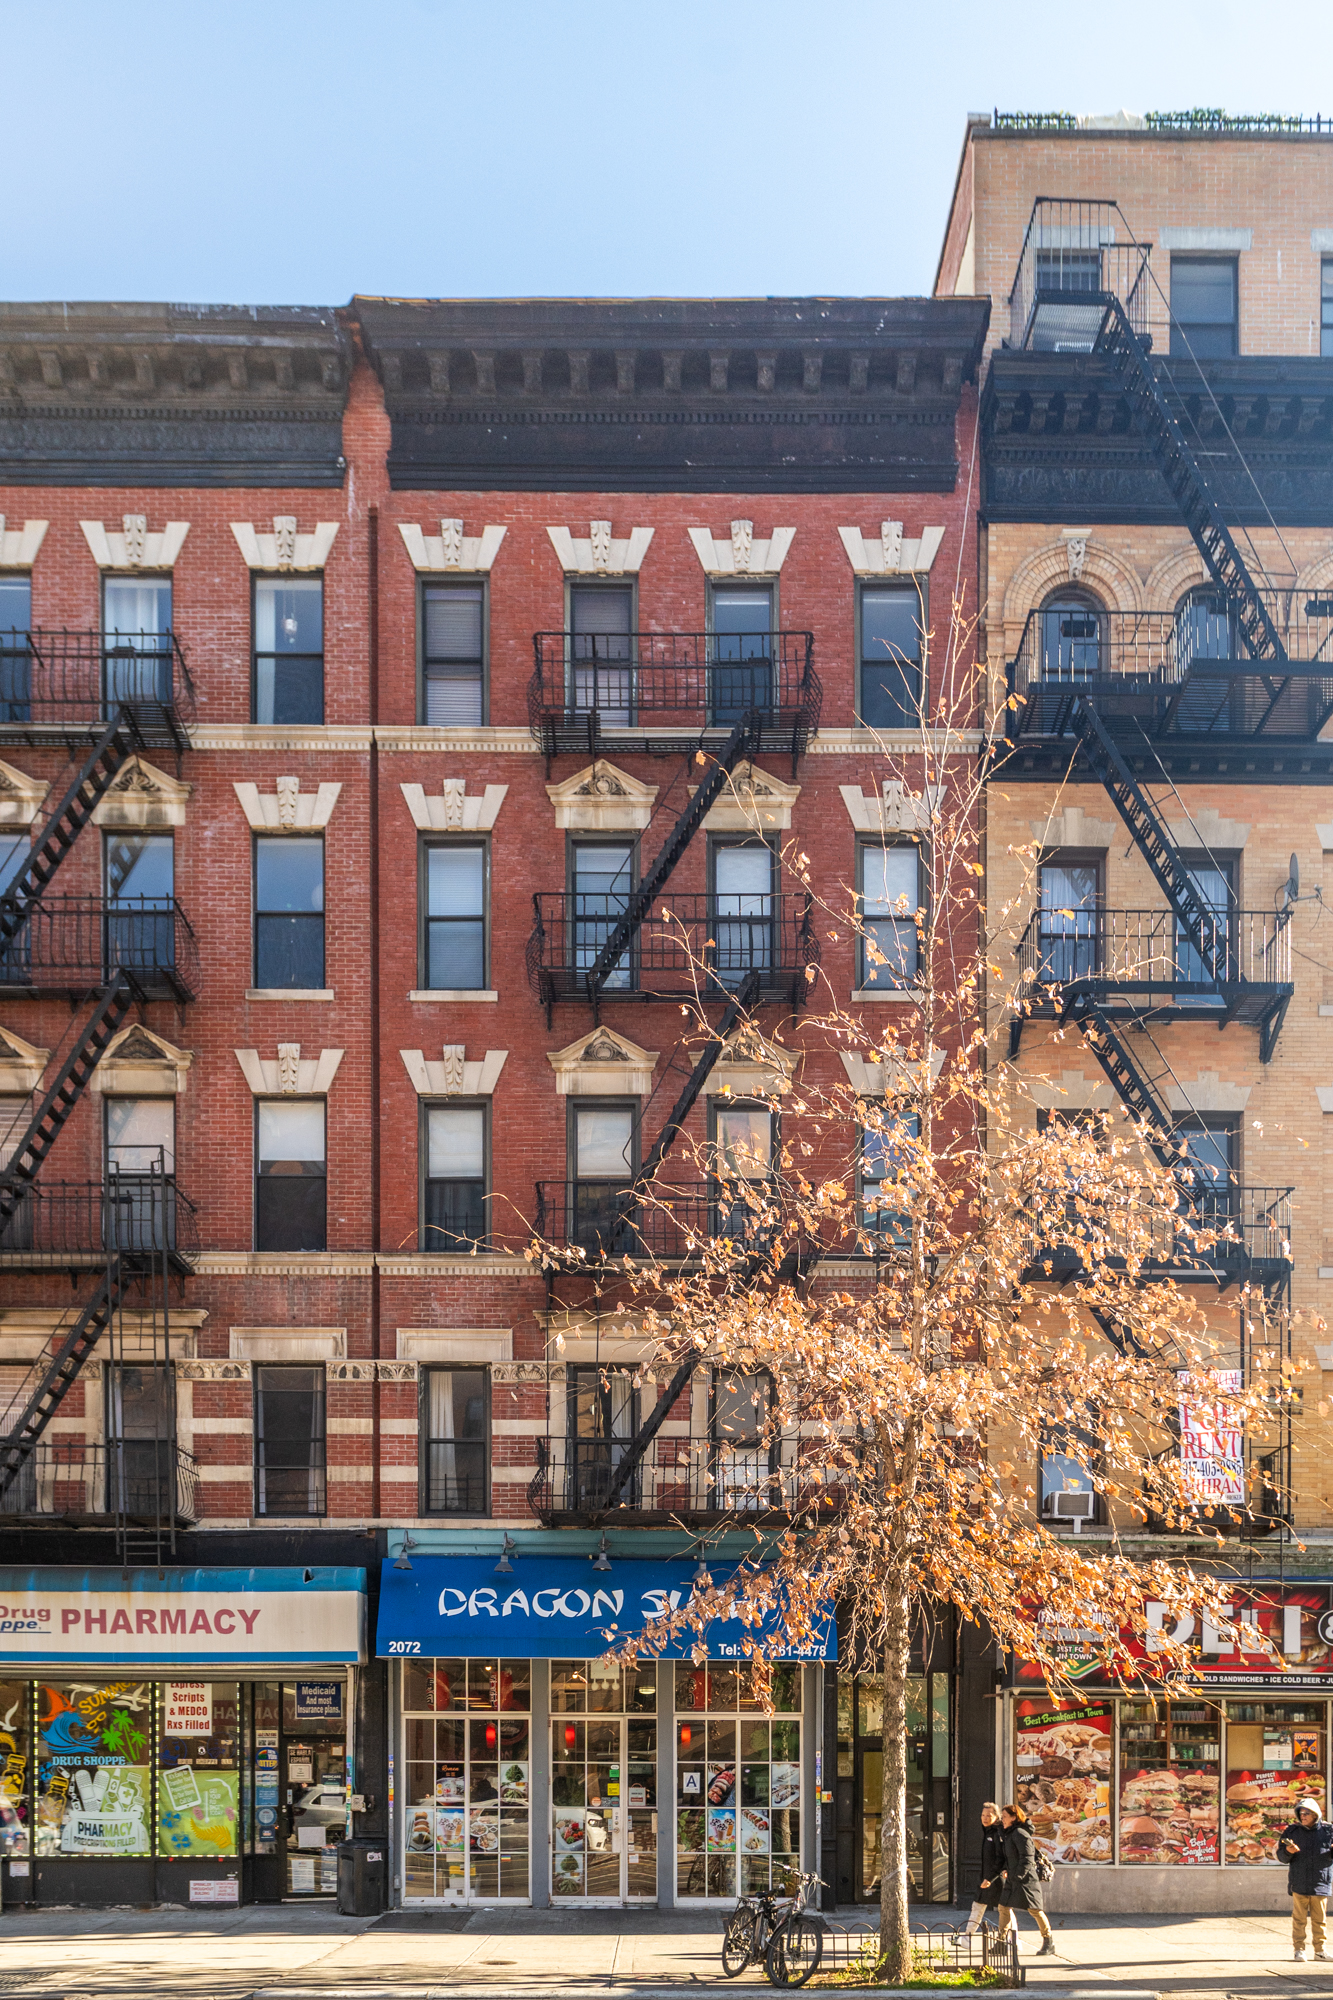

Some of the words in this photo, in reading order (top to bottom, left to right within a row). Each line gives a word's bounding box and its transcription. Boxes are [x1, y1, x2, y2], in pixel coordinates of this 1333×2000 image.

[1182, 1430, 1240, 1459] RENT
[438, 1587, 624, 1618] DRAGON
[61, 1608, 261, 1635] PHARMACY
[1145, 1601, 1302, 1655] DELI
[388, 1641, 421, 1653] 2072
[718, 1643, 741, 1656] Tel:
[301, 1686, 336, 1695] Medicaid
[78, 1682, 137, 1714] SUMM
[172, 1692, 205, 1703] Scripts
[306, 1696, 317, 1705] And
[318, 1697, 332, 1705] most
[169, 1707, 176, 1716] &
[178, 1706, 208, 1716] MEDCO
[297, 1705, 324, 1714] Insurance
[324, 1705, 341, 1715] plans.
[1024, 1715, 1041, 1726] Best
[1041, 1713, 1077, 1724] Breakfast
[1085, 1707, 1104, 1717] Town
[167, 1720, 183, 1729] Rxs
[185, 1720, 210, 1730] Filled
[52, 1756, 81, 1766] DRUG
[83, 1756, 126, 1766] SHOPPE
[686, 1775, 697, 1787] A
[1016, 1774, 1034, 1782] Coffee
[1256, 1772, 1276, 1780] PERFECT
[1246, 1778, 1274, 1787] SANDWICHES
[1267, 1780, 1288, 1788] BURGERS
[1092, 1801, 1107, 1810] Juice
[78, 1821, 132, 1837] PHARMACY
[117, 1836, 137, 1847] FILLED
[1189, 1837, 1207, 1847] Best
[1182, 1844, 1216, 1857] Sandwich
